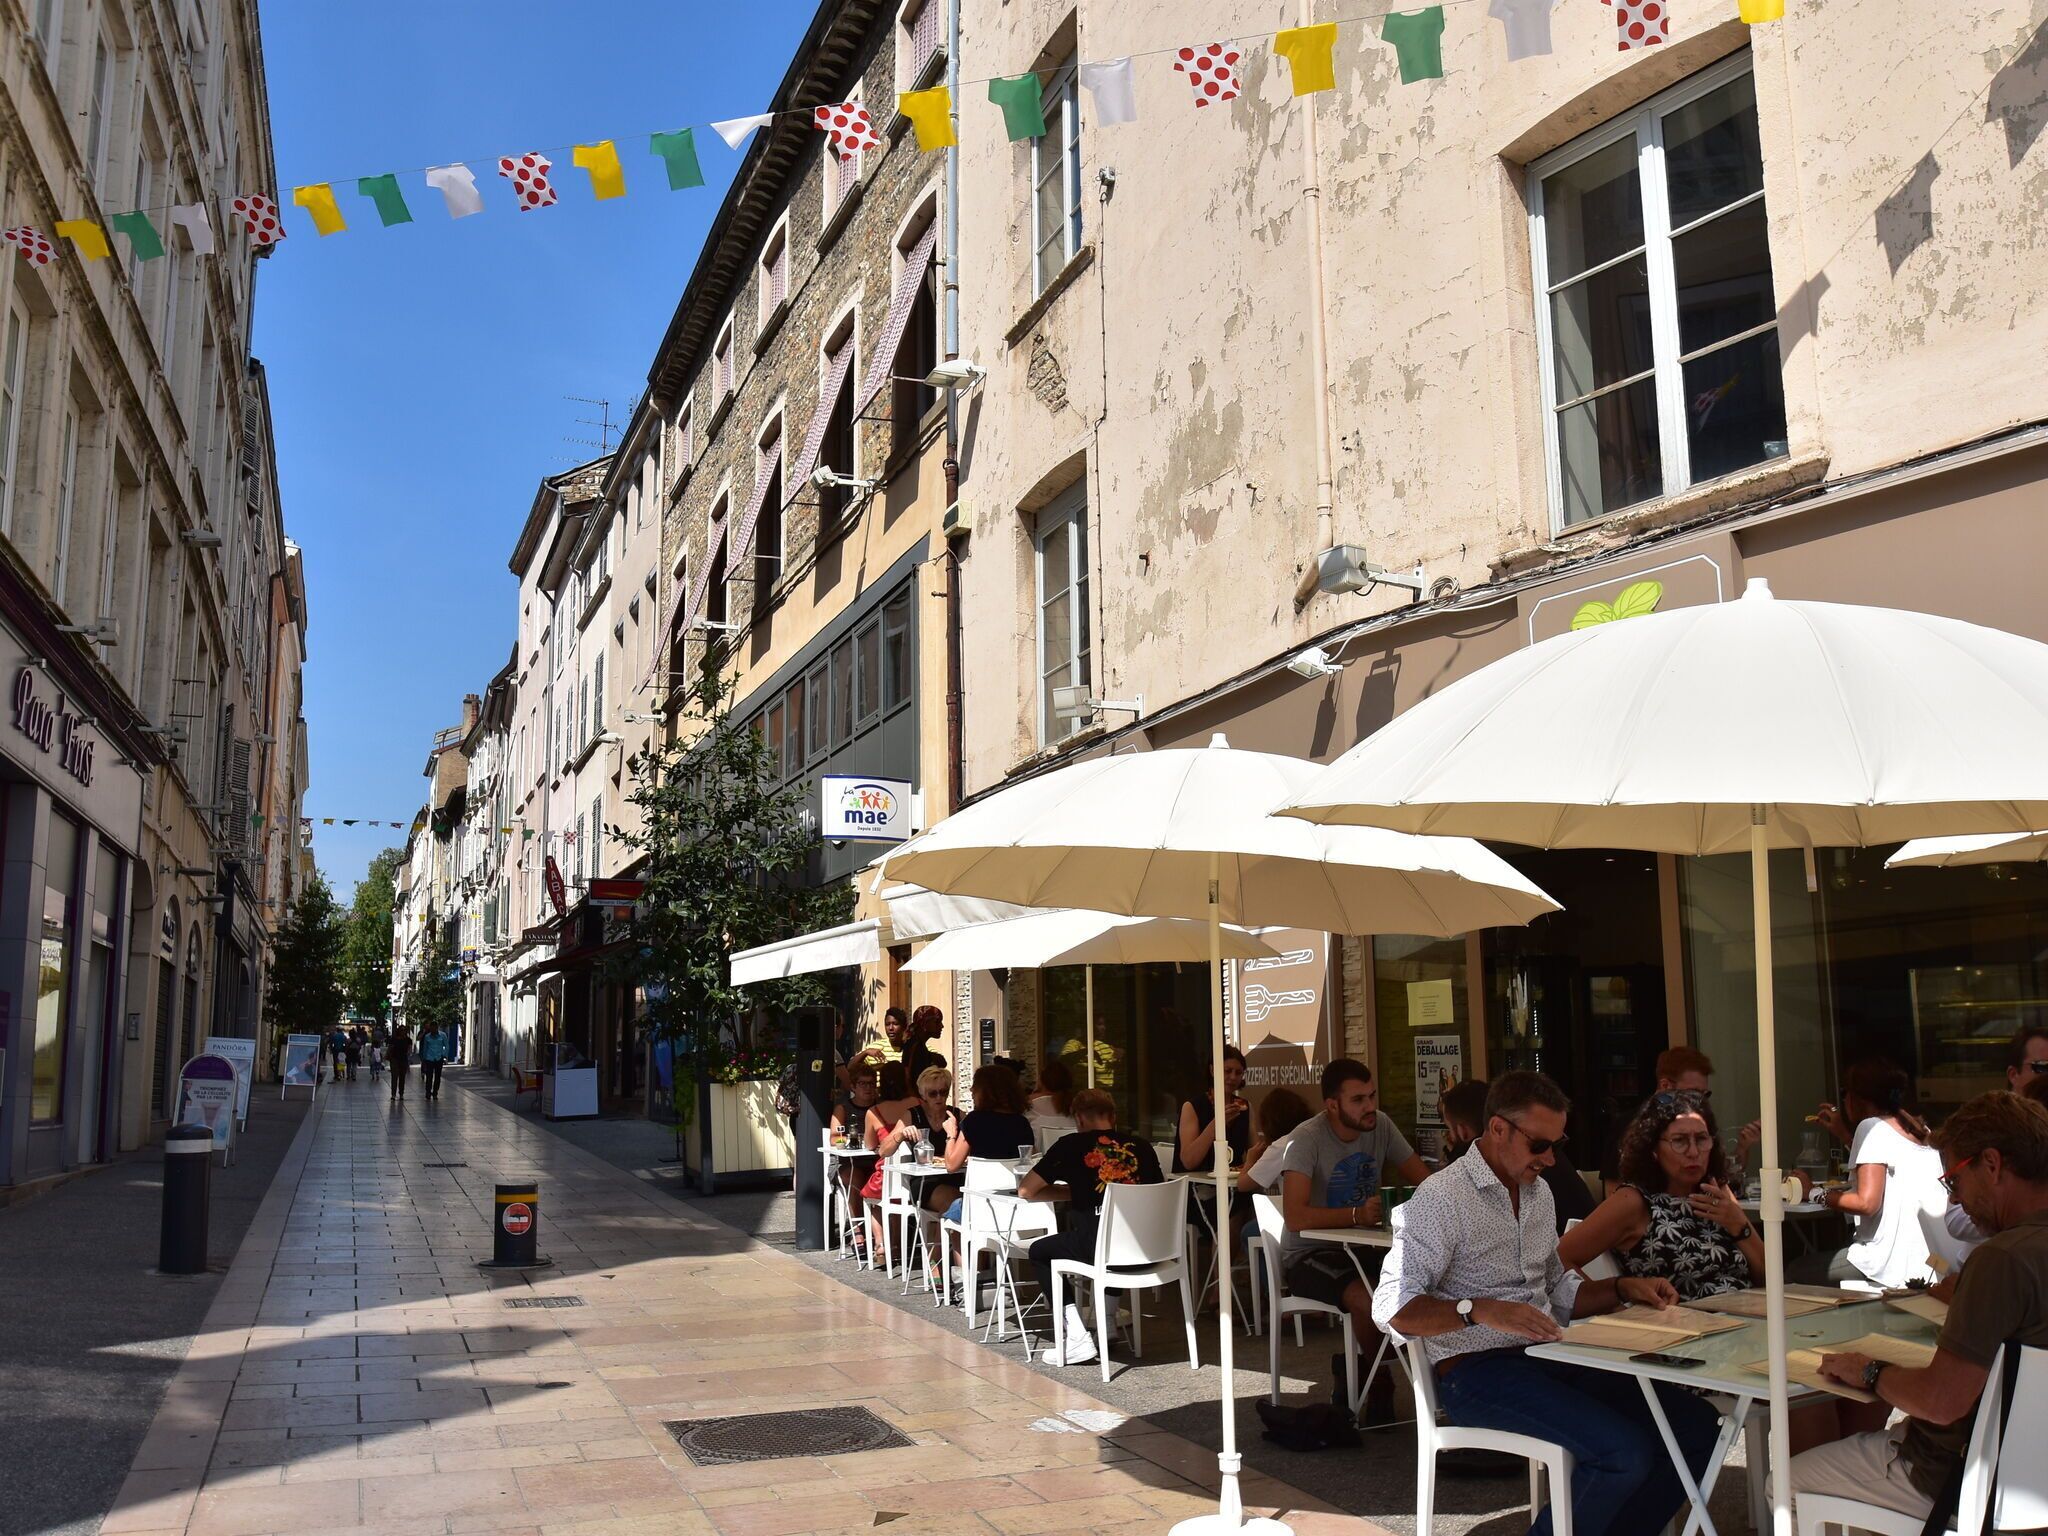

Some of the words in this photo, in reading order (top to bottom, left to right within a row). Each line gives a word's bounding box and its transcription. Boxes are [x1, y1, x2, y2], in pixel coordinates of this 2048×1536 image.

[844, 785, 855, 795] La
[844, 810, 887, 825] mae
[548, 859, 565, 915] TABAC
[1417, 1045, 1459, 1056] DEBALLAGE
[1271, 1065, 1279, 1086] ET
[1417, 1061, 1428, 1078] 15
